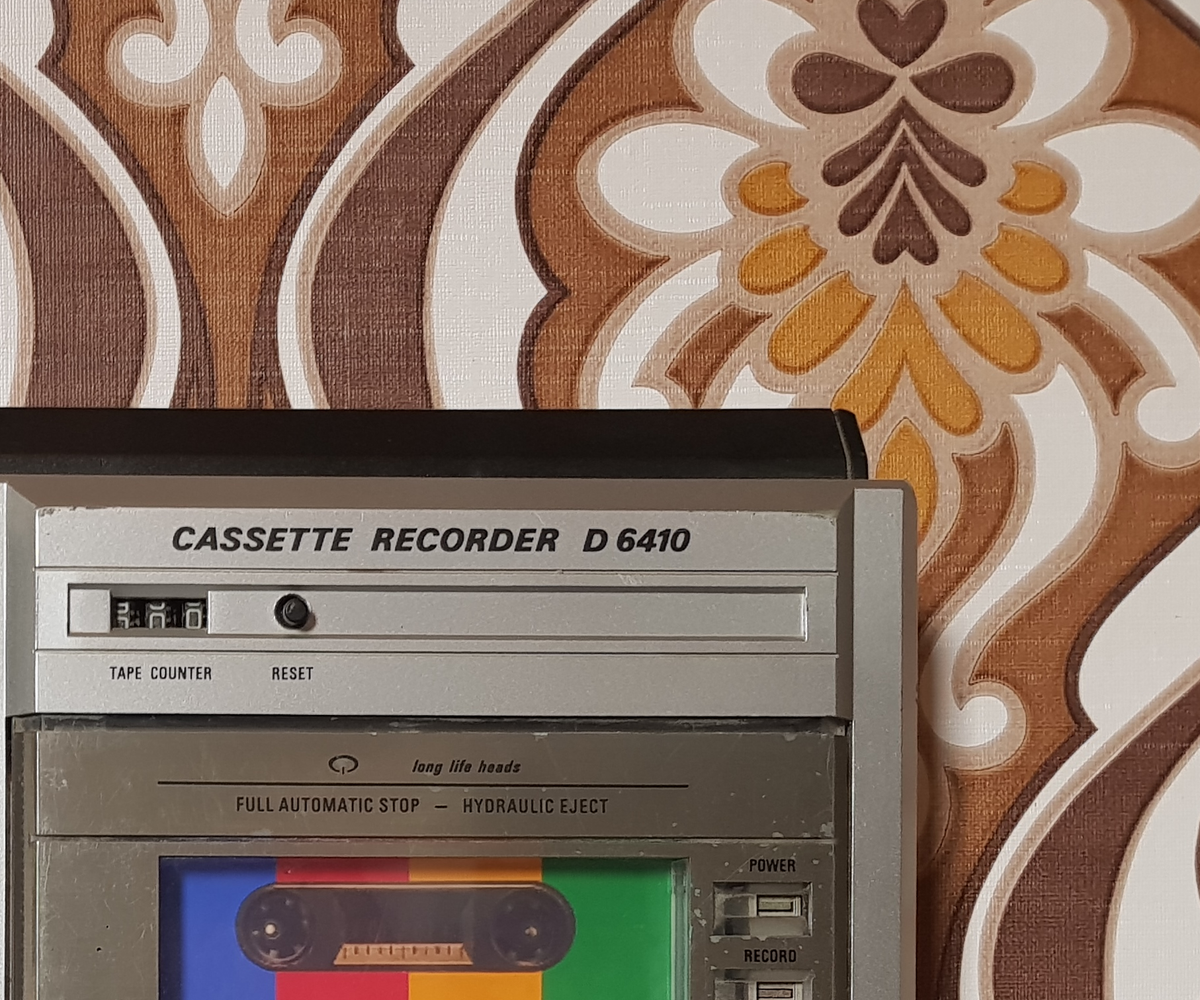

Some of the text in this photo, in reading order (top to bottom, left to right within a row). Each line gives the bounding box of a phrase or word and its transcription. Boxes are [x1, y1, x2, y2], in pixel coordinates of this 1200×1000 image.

[172, 526, 354, 552] CASSETTE
[370, 527, 560, 553] RECORDER
[109, 666, 212, 681] TAPE COUNTER
[271, 666, 314, 681] RESET
[412, 759, 522, 776] long life heads
[236, 796, 274, 812] FULL
[278, 796, 373, 813] AUTOMATIC
[379, 797, 420, 813] STOP
[463, 798, 554, 814] HYDRAULIC
[560, 798, 609, 814] EJECT
[749, 858, 796, 873] POWER
[744, 948, 797, 963] RECORD
